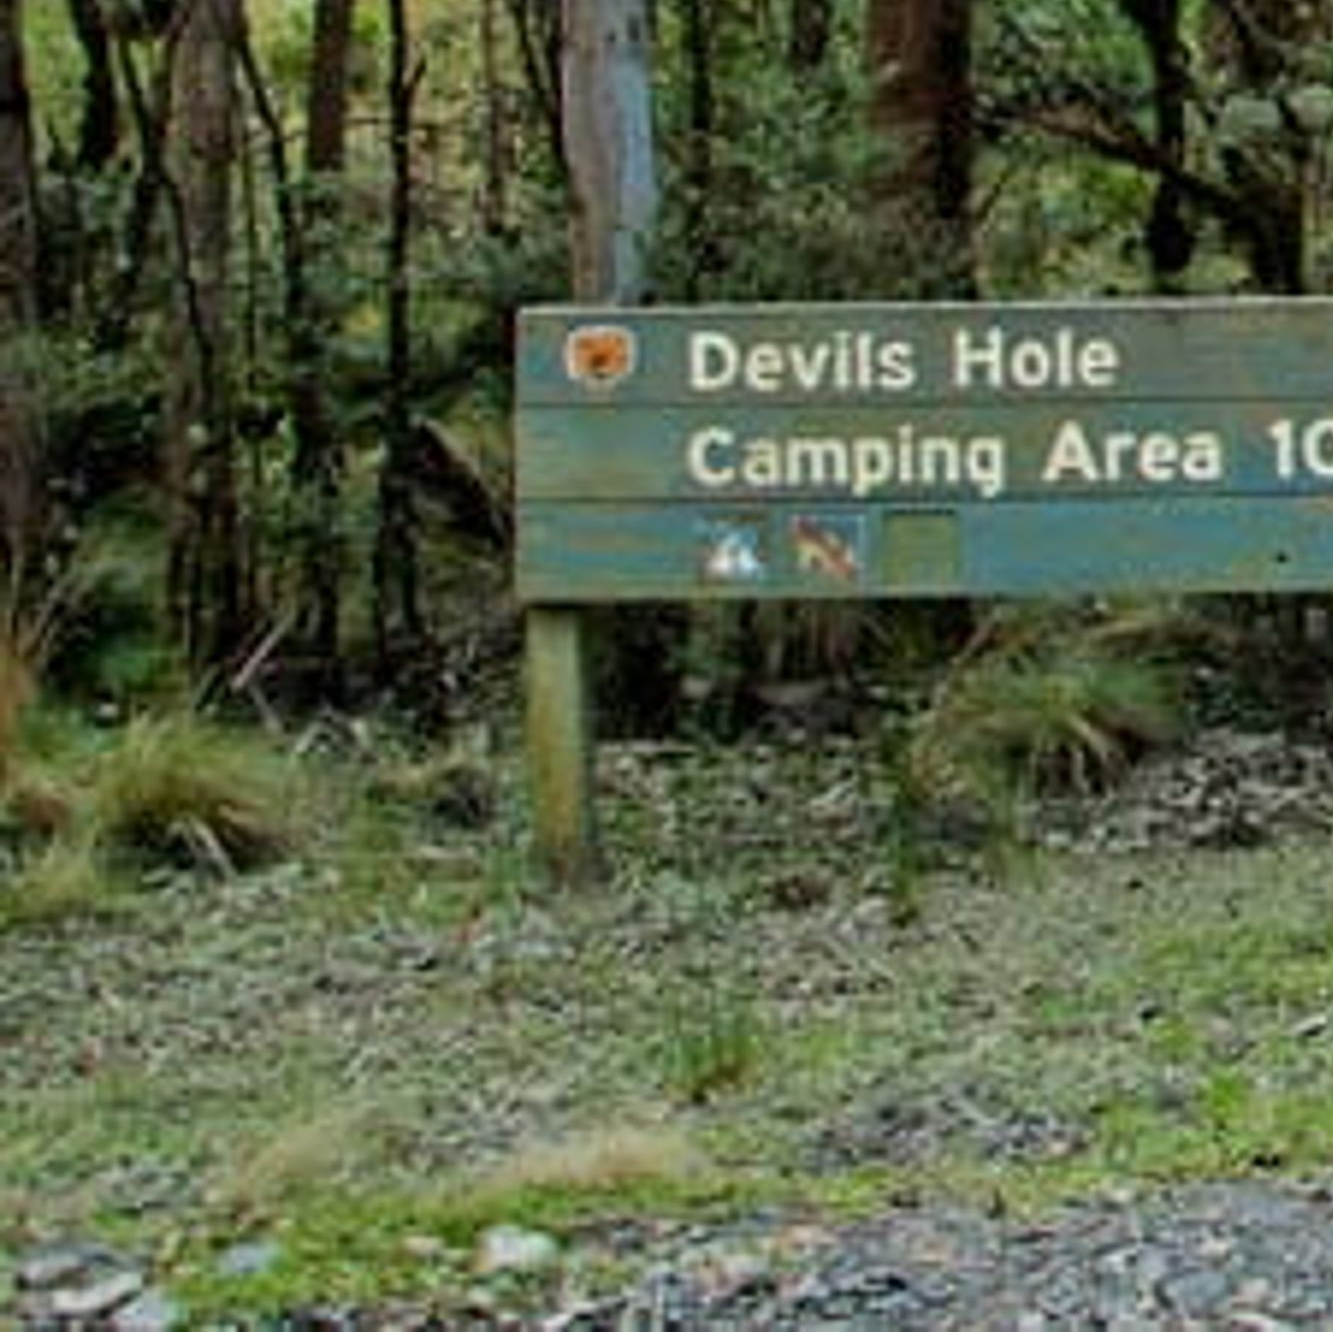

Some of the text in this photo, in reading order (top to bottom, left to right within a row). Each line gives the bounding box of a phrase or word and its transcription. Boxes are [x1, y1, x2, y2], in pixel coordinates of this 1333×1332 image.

[689, 328, 1121, 392] Devils Hole
[687, 425, 1003, 497] Camping
[1041, 419, 1223, 483] Area
